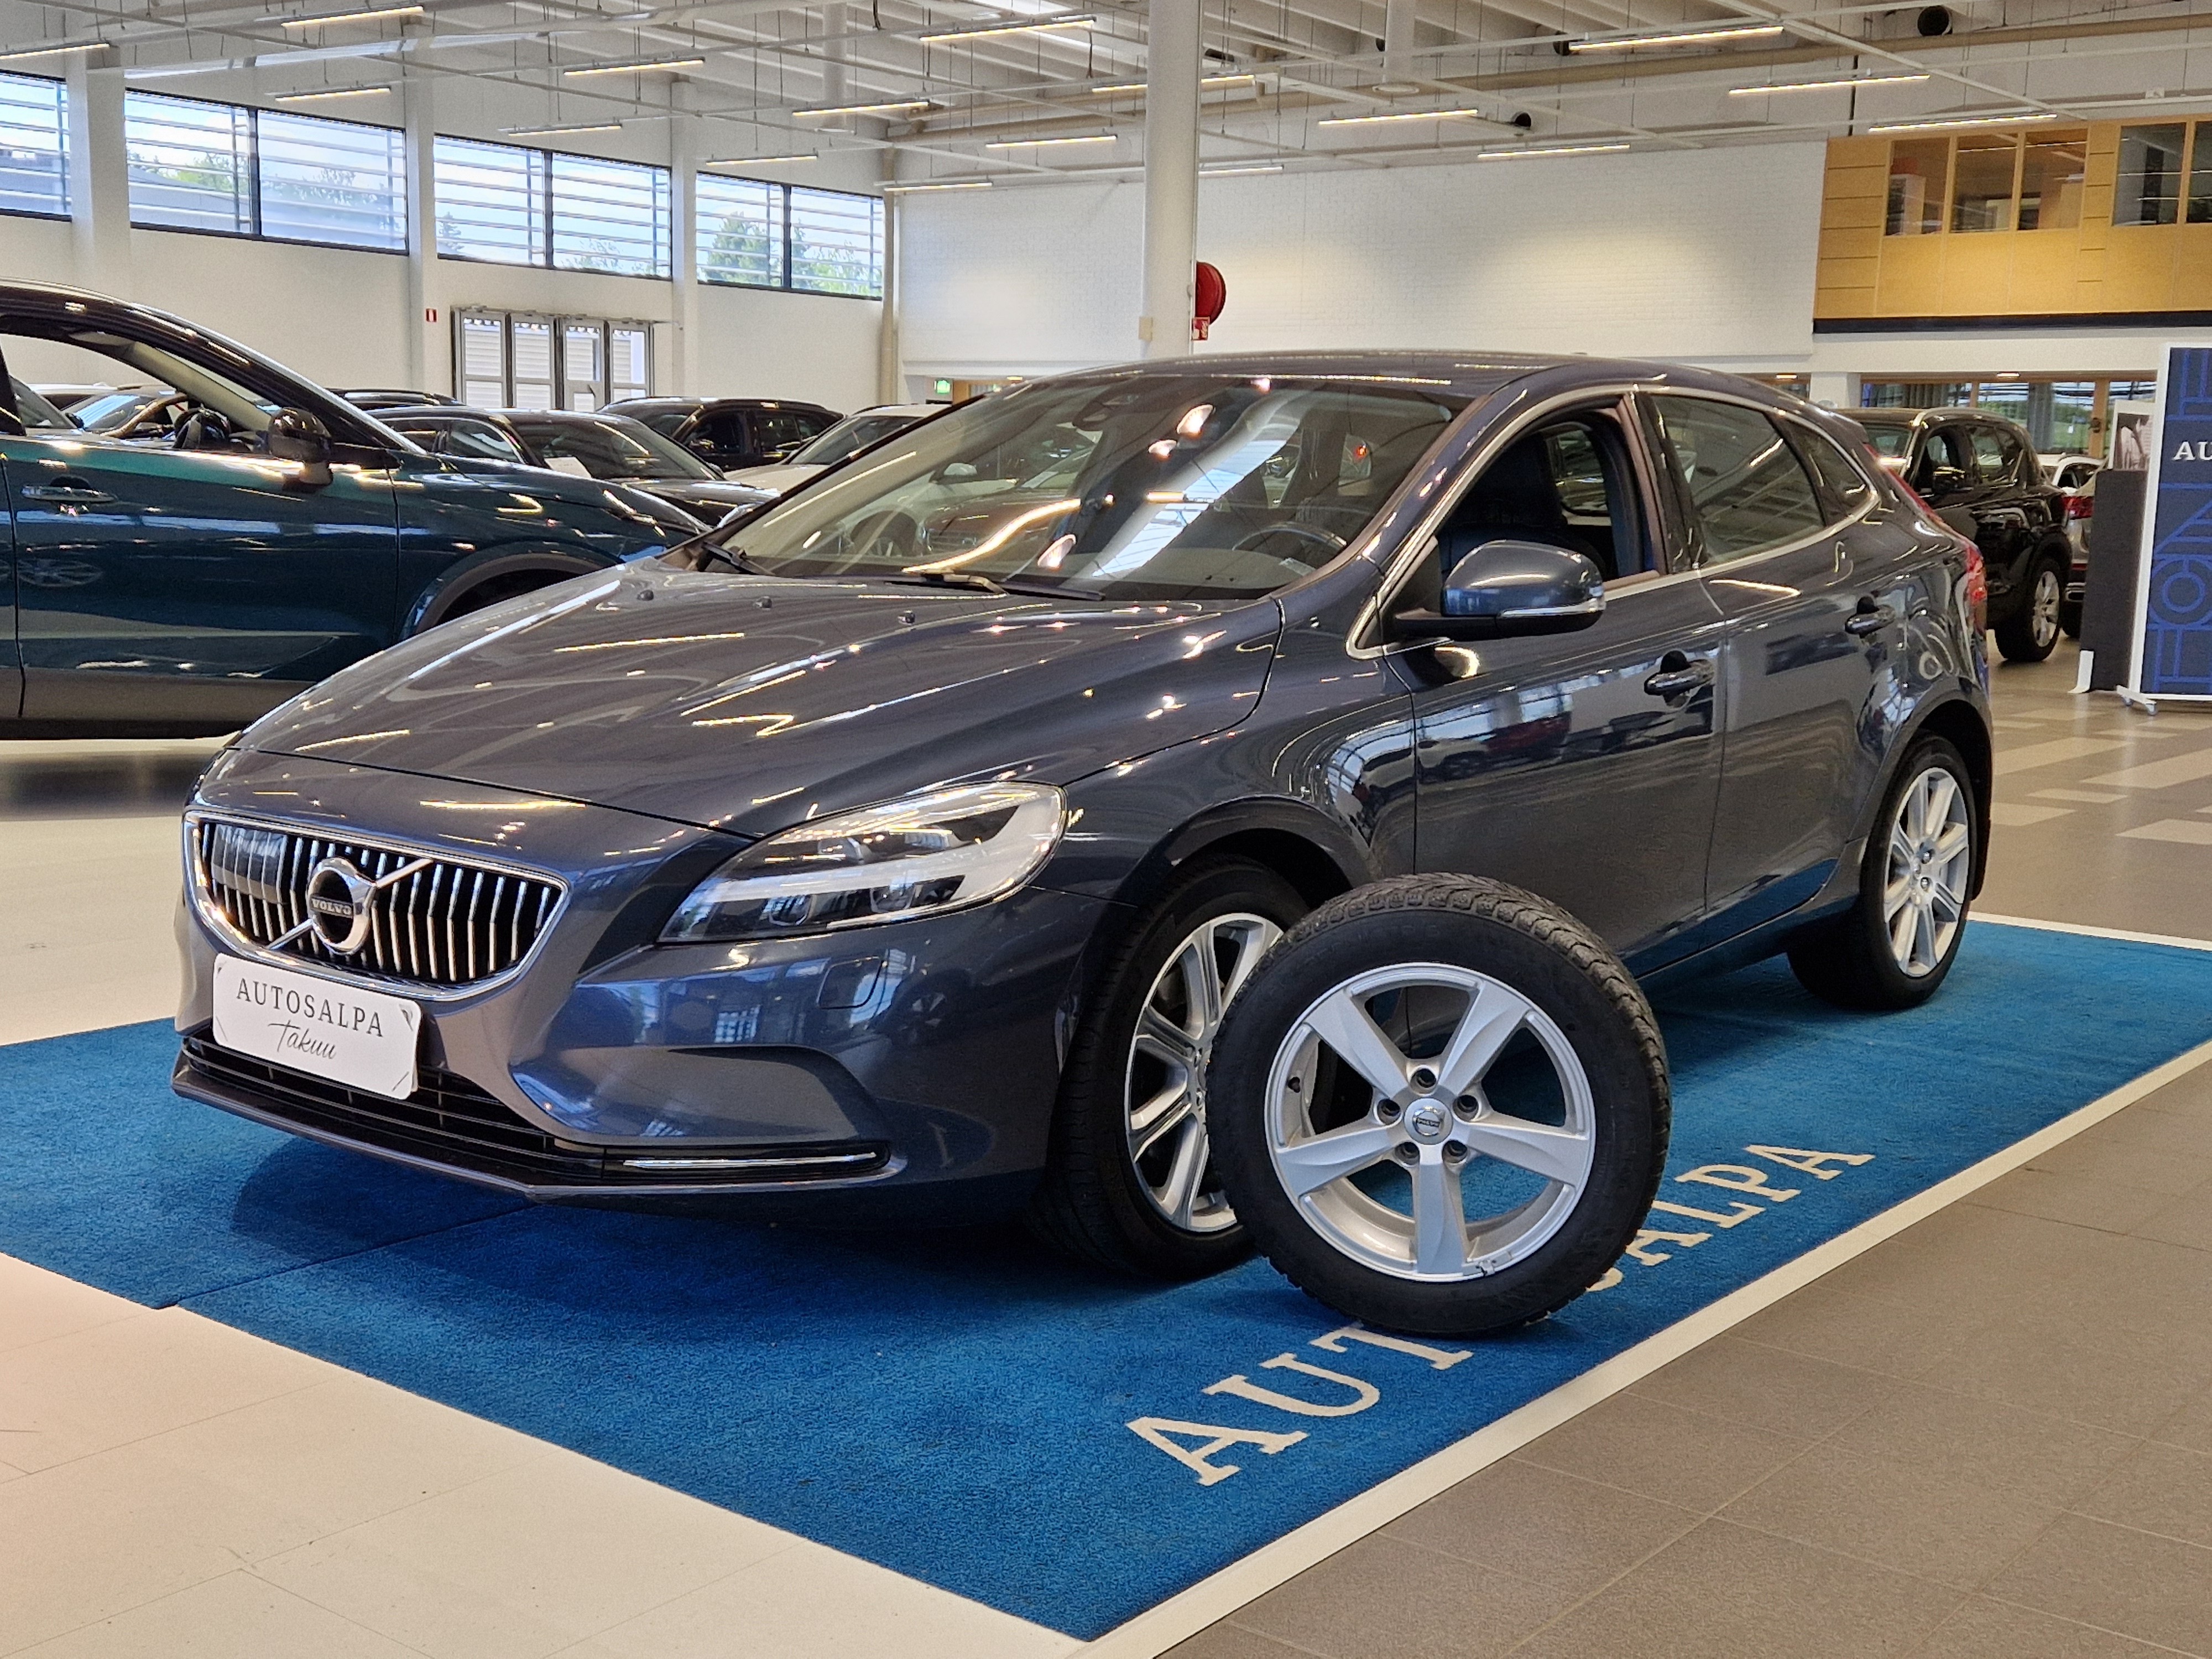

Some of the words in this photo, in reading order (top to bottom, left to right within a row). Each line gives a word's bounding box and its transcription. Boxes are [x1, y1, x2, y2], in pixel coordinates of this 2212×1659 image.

[311, 898, 352, 915] VOLVO
[236, 978, 383, 1037] AUTOSALPA
[268, 1020, 336, 1059] Takuu
[1126, 1144, 1876, 1486] AUTALPA
